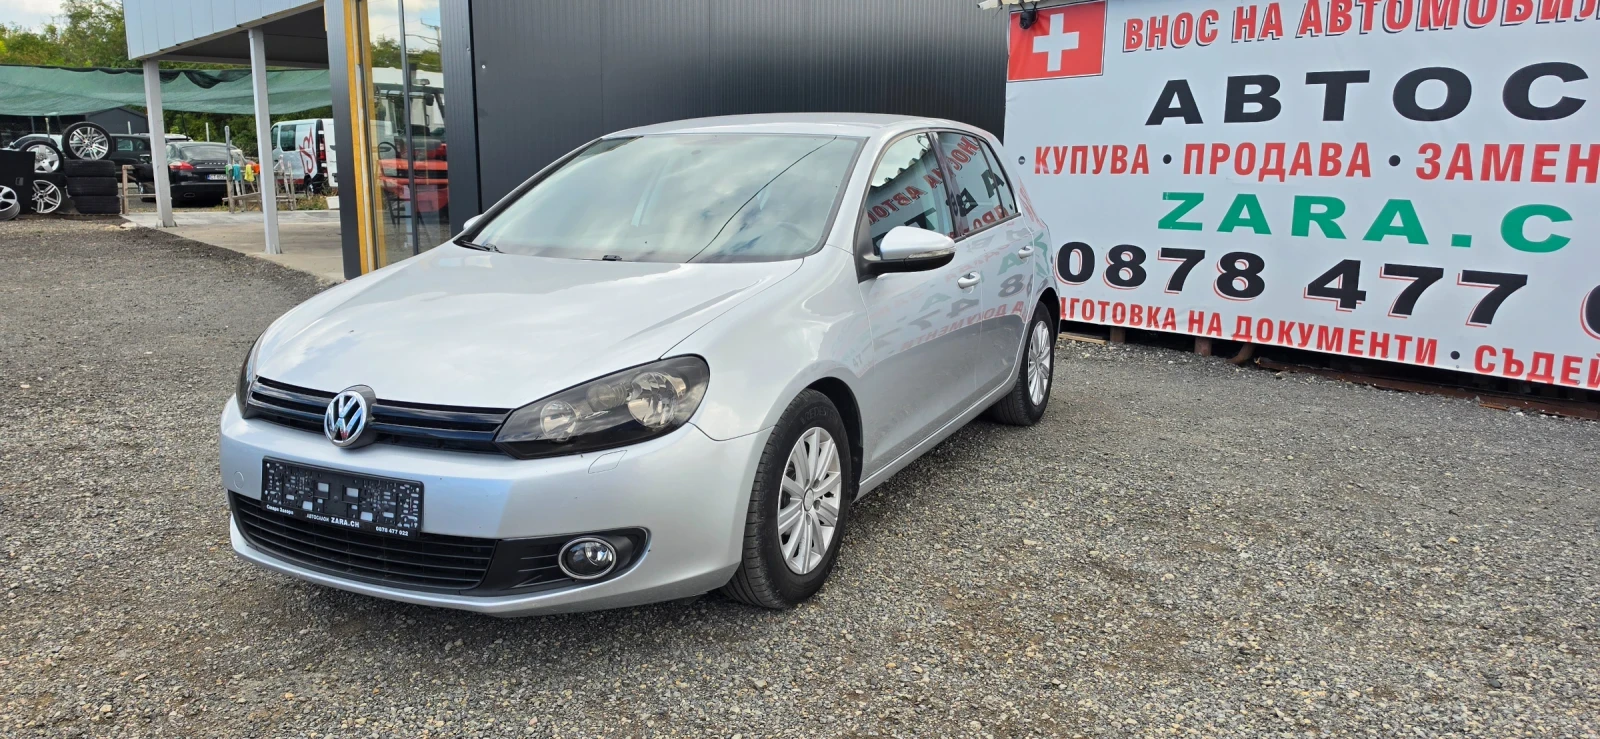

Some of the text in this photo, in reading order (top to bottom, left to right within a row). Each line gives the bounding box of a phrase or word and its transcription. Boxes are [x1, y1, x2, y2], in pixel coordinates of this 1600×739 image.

[1123, 9, 1219, 52] ВНОС
[1232, 2, 1284, 43] НА
[1145, 62, 1589, 126] АВТОС
[1034, 142, 1600, 183] КУПУВА ПРОДАВА ЗАМЕН
[1157, 191, 1573, 253] ZARA.C
[1054, 241, 1265, 301] 0878
[1304, 259, 1528, 328] 477
[1188, 310, 1222, 337] НА
[1232, 315, 1439, 366] ДОКУМЕНТИ
[331, 517, 360, 528] ZARA.CH
